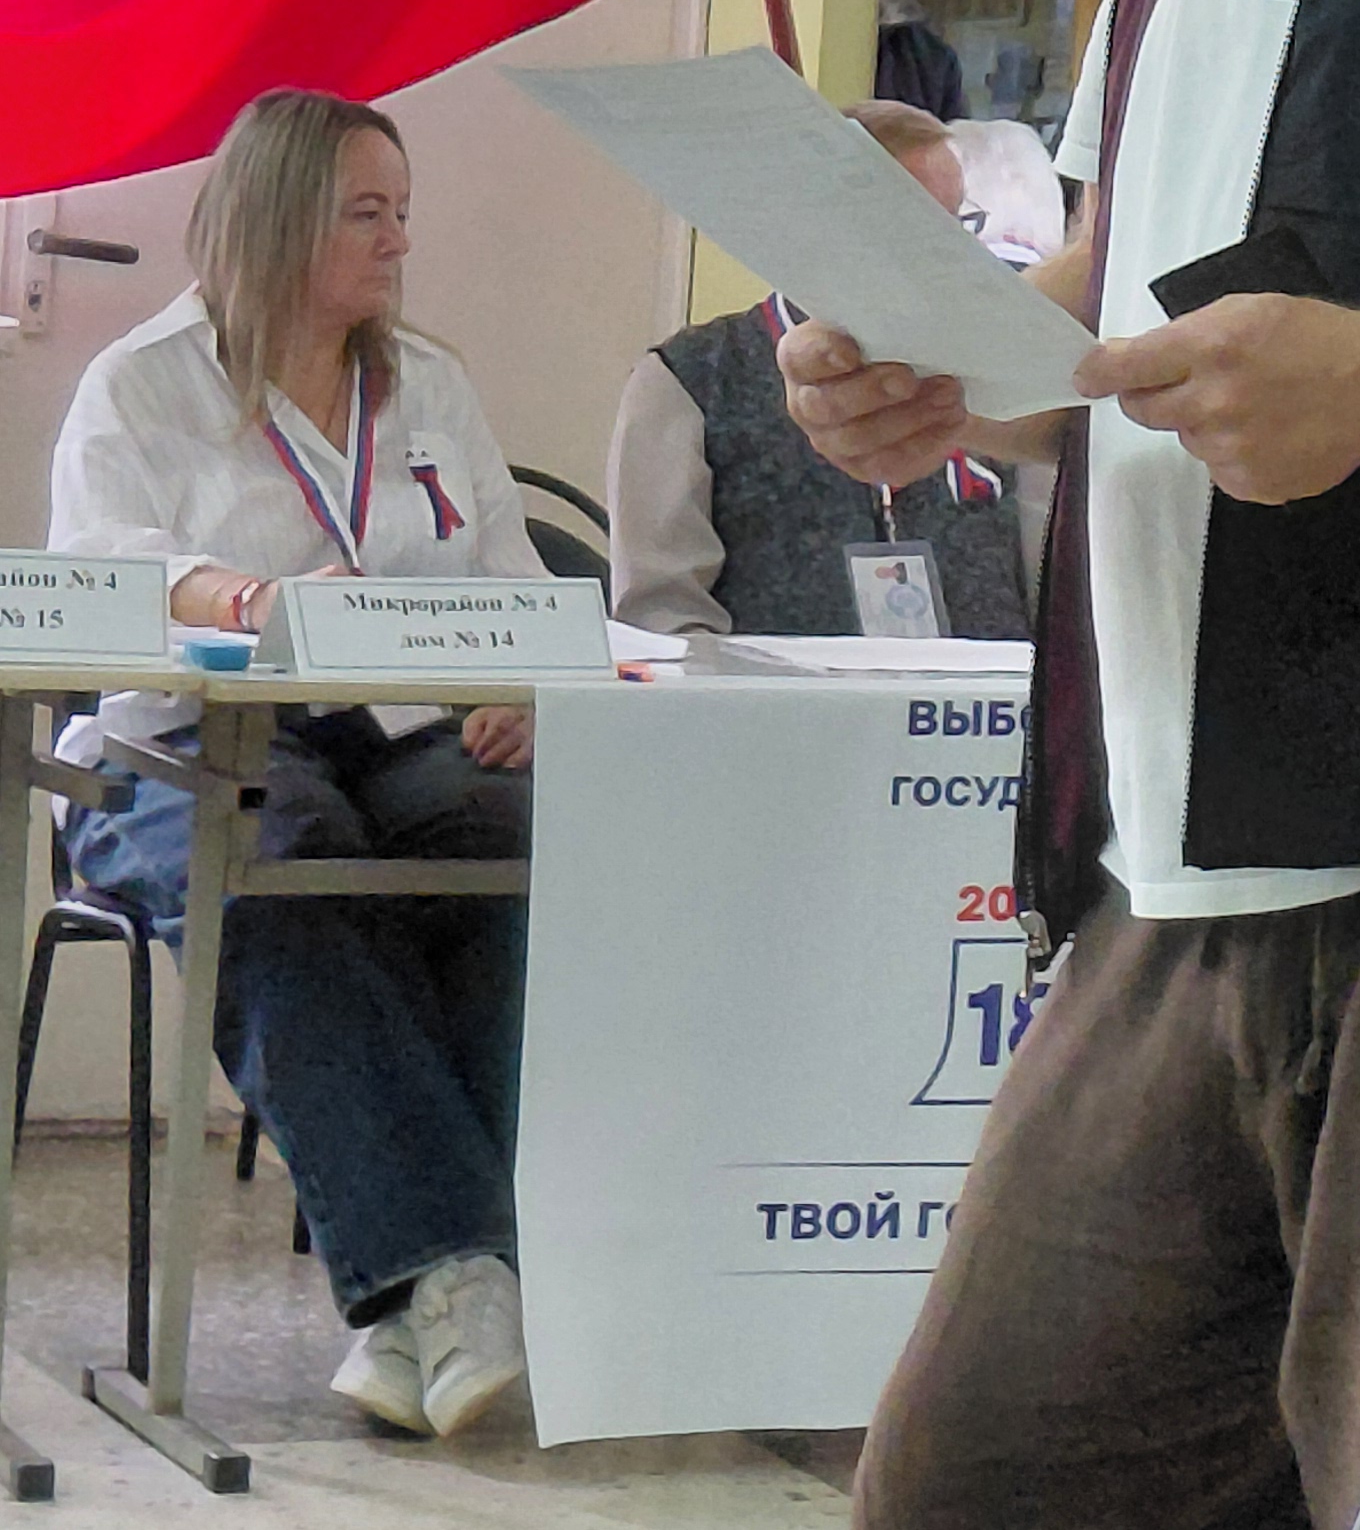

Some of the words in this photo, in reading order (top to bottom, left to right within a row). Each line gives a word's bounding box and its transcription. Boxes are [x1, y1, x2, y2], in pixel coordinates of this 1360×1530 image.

[103, 572, 117, 590] 4
[343, 592, 503, 617] Микрорайон
[545, 595, 559, 612] 4
[37, 608, 64, 628] 15
[400, 632, 446, 649] дом
[489, 629, 515, 649] 14
[891, 776, 1028, 812] ГОСУД
[956, 884, 1018, 922] 20
[756, 1190, 900, 1240] ТВОЙ
